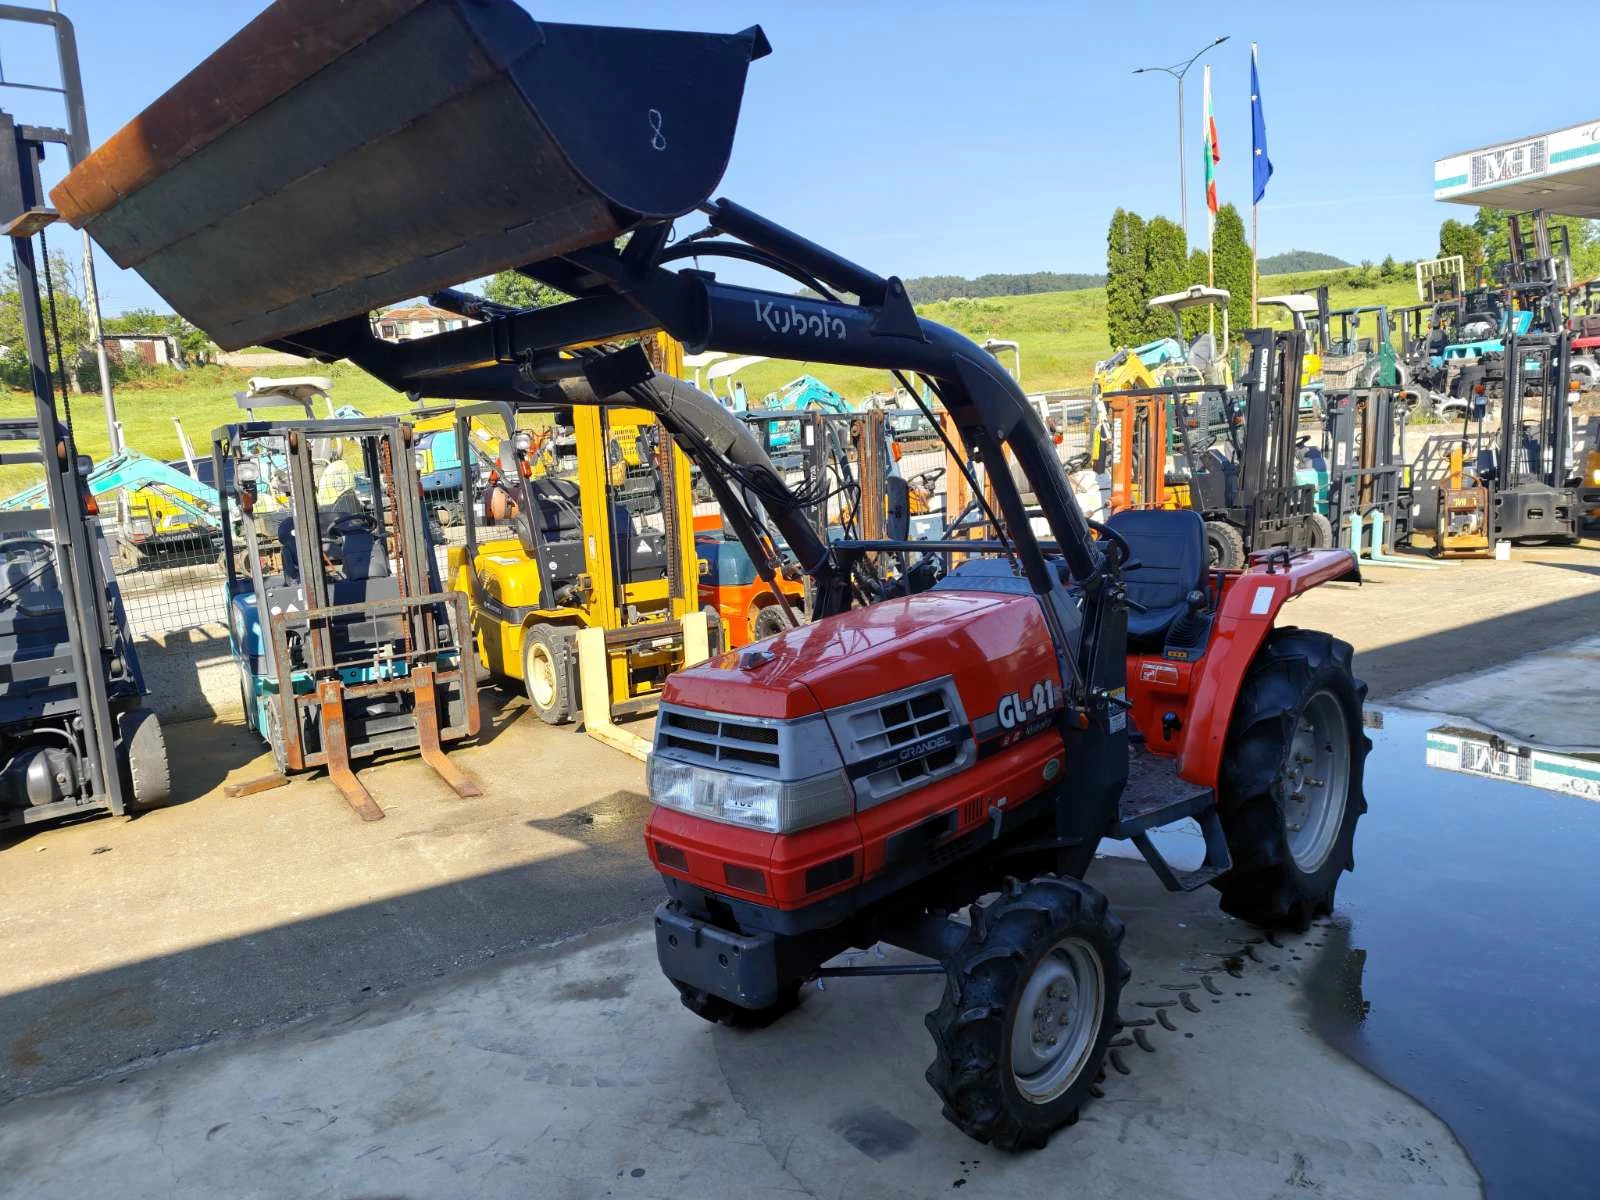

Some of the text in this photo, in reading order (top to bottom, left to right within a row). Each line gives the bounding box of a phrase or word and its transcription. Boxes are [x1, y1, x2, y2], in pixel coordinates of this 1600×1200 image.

[649, 109, 667, 151] 8
[755, 299, 847, 340] Kubota
[1113, 417, 1122, 464] NISSAN
[159, 532, 199, 542] YANMAR
[998, 679, 1055, 729] GL-21
[899, 736, 952, 760] GRANDEL
